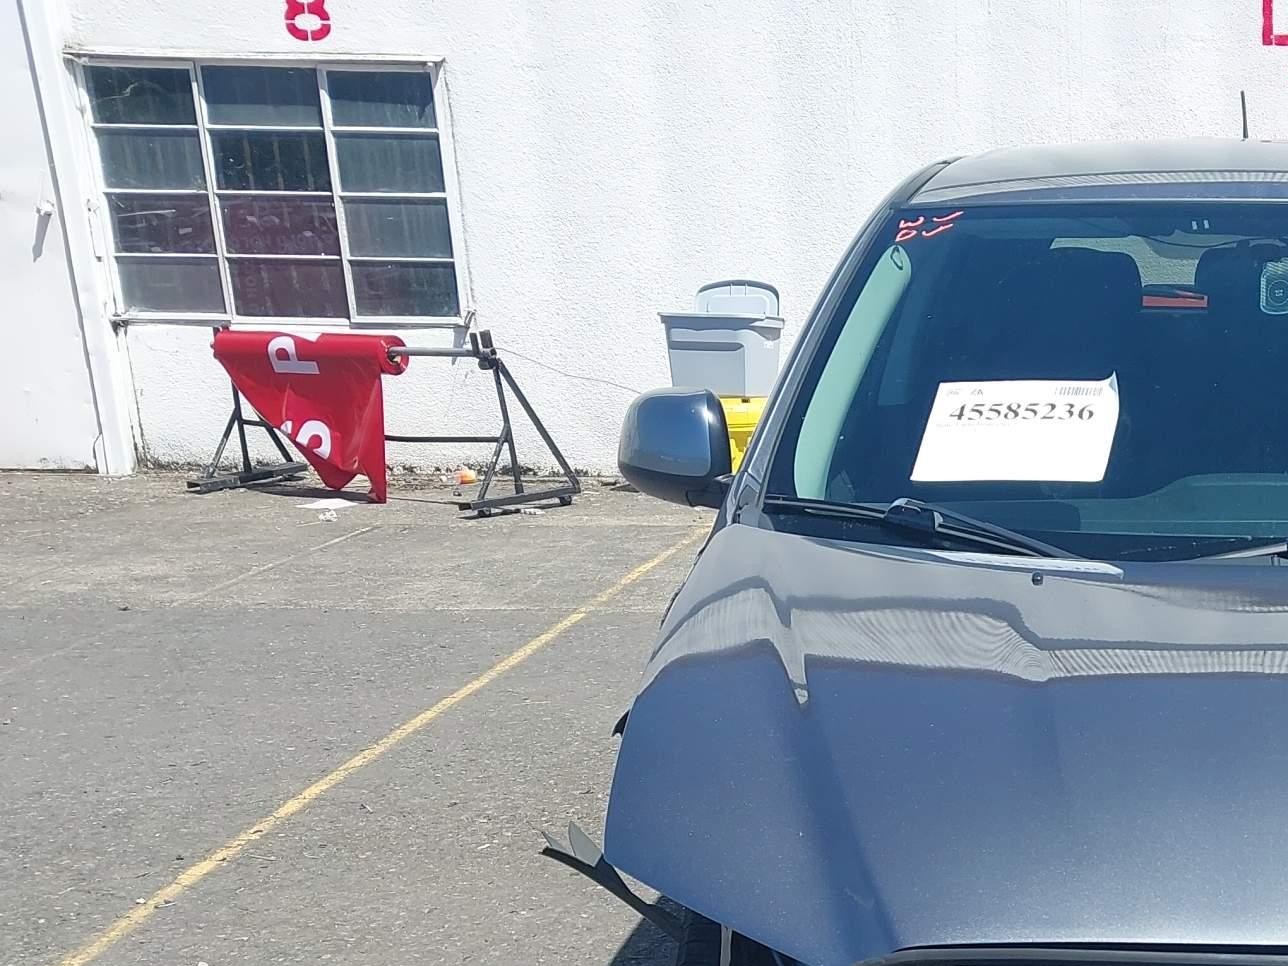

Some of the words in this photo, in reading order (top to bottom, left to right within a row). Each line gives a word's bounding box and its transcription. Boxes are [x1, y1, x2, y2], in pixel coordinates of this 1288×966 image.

[284, 0, 332, 42] 8
[267, 335, 320, 375] P
[948, 402, 1095, 421] 45585236
